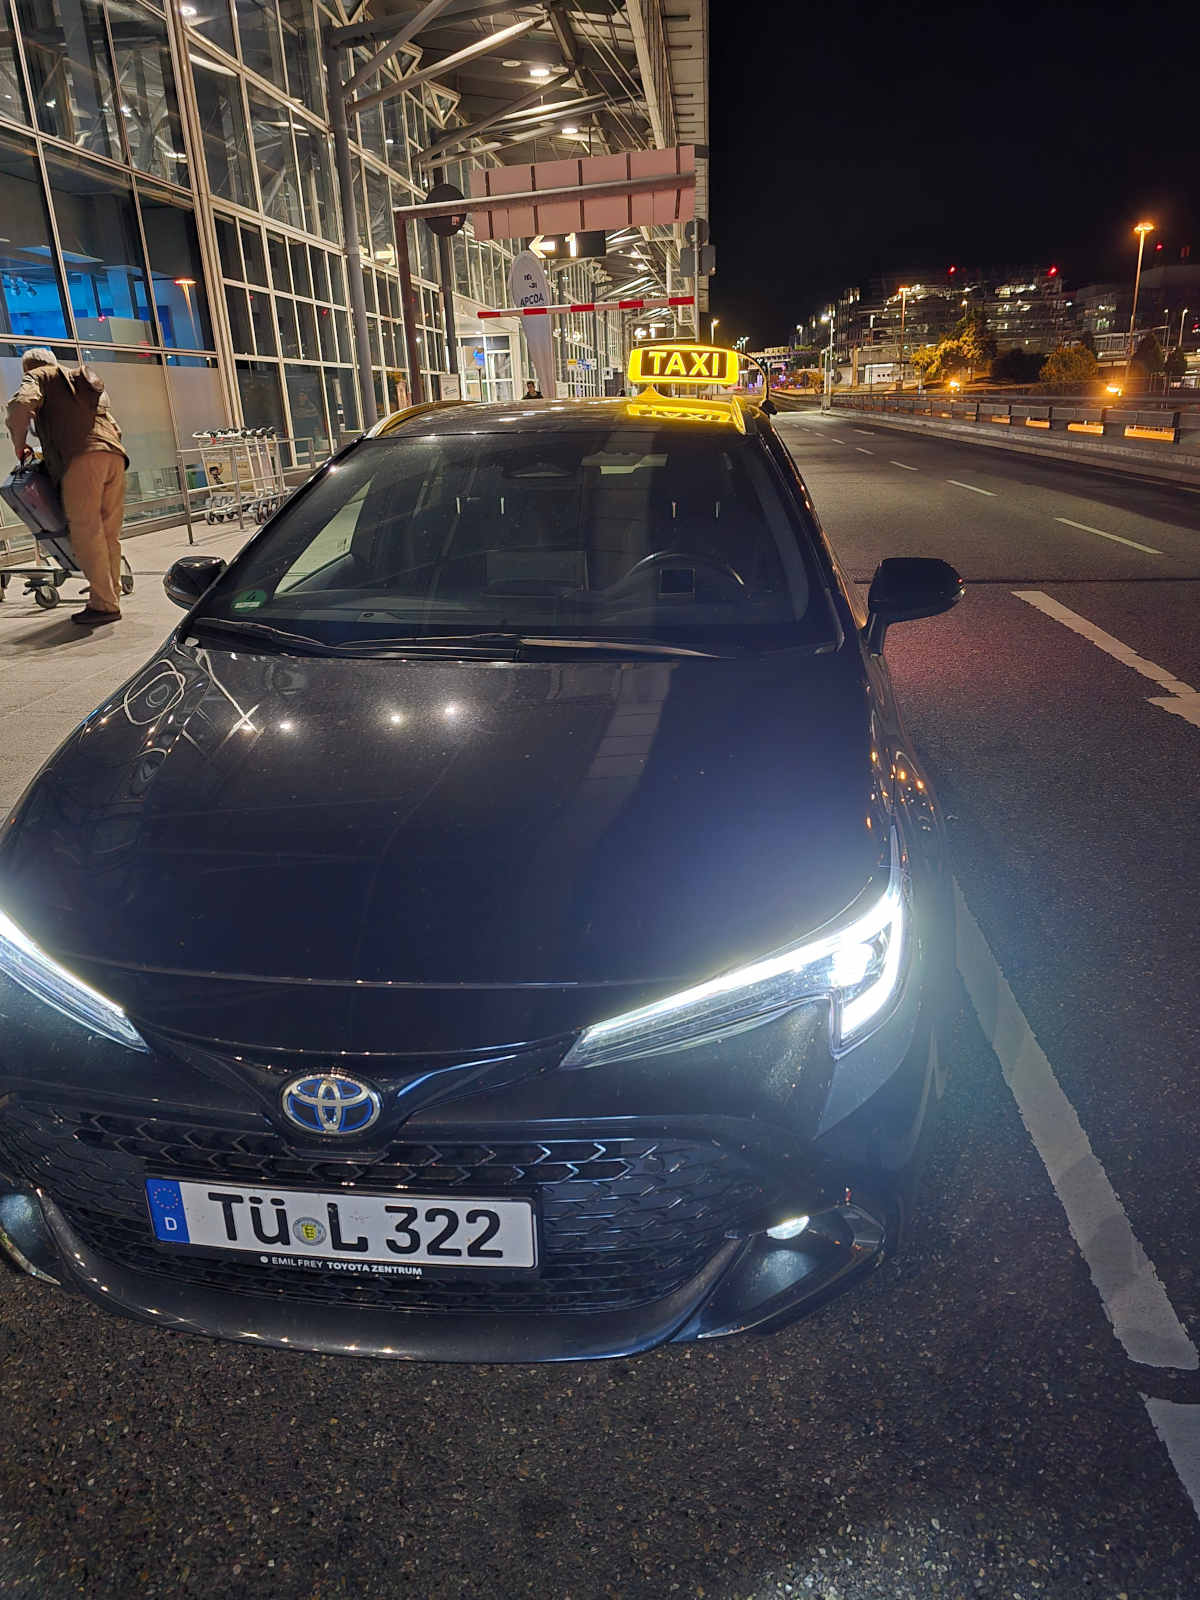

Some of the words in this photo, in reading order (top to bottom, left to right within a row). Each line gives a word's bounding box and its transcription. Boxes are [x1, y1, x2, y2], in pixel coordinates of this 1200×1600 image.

[565, 232, 577, 257] 1
[521, 293, 545, 306] APCOA
[648, 351, 720, 377] TAXI
[165, 1216, 178, 1231] D
[207, 1191, 291, 1246] TÜ
[327, 1202, 369, 1252] L
[384, 1204, 504, 1258] 322
[272, 1256, 297, 1267] EMIL
[298, 1258, 323, 1269] FREY
[327, 1261, 370, 1272] TOYOTA
[371, 1264, 423, 1276] ZENTRUM
